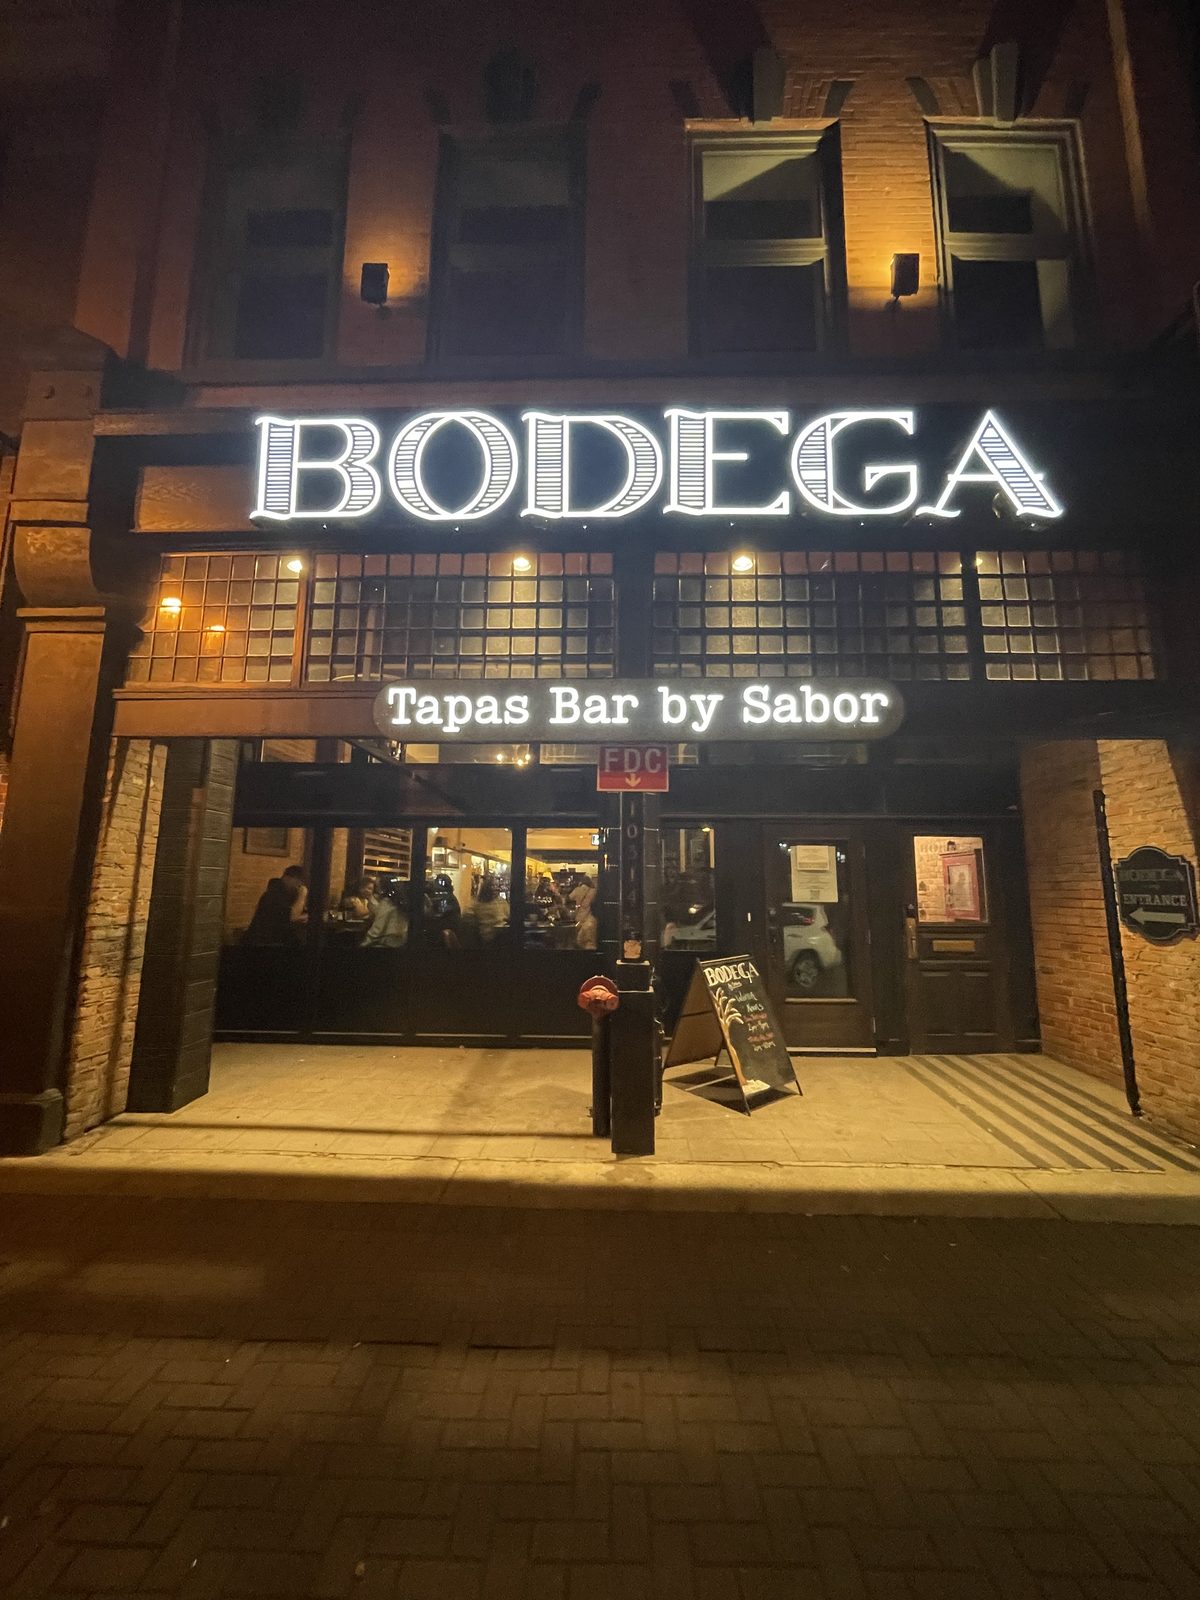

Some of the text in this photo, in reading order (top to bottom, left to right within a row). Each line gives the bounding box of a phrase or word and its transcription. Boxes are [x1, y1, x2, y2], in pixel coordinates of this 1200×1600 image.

[249, 408, 1064, 522] BODEGA
[387, 683, 890, 733] Tapas Bar by Sabor
[603, 747, 662, 773] FDC
[1122, 893, 1188, 908] ENTRANCE
[703, 961, 760, 987] BODEGA
